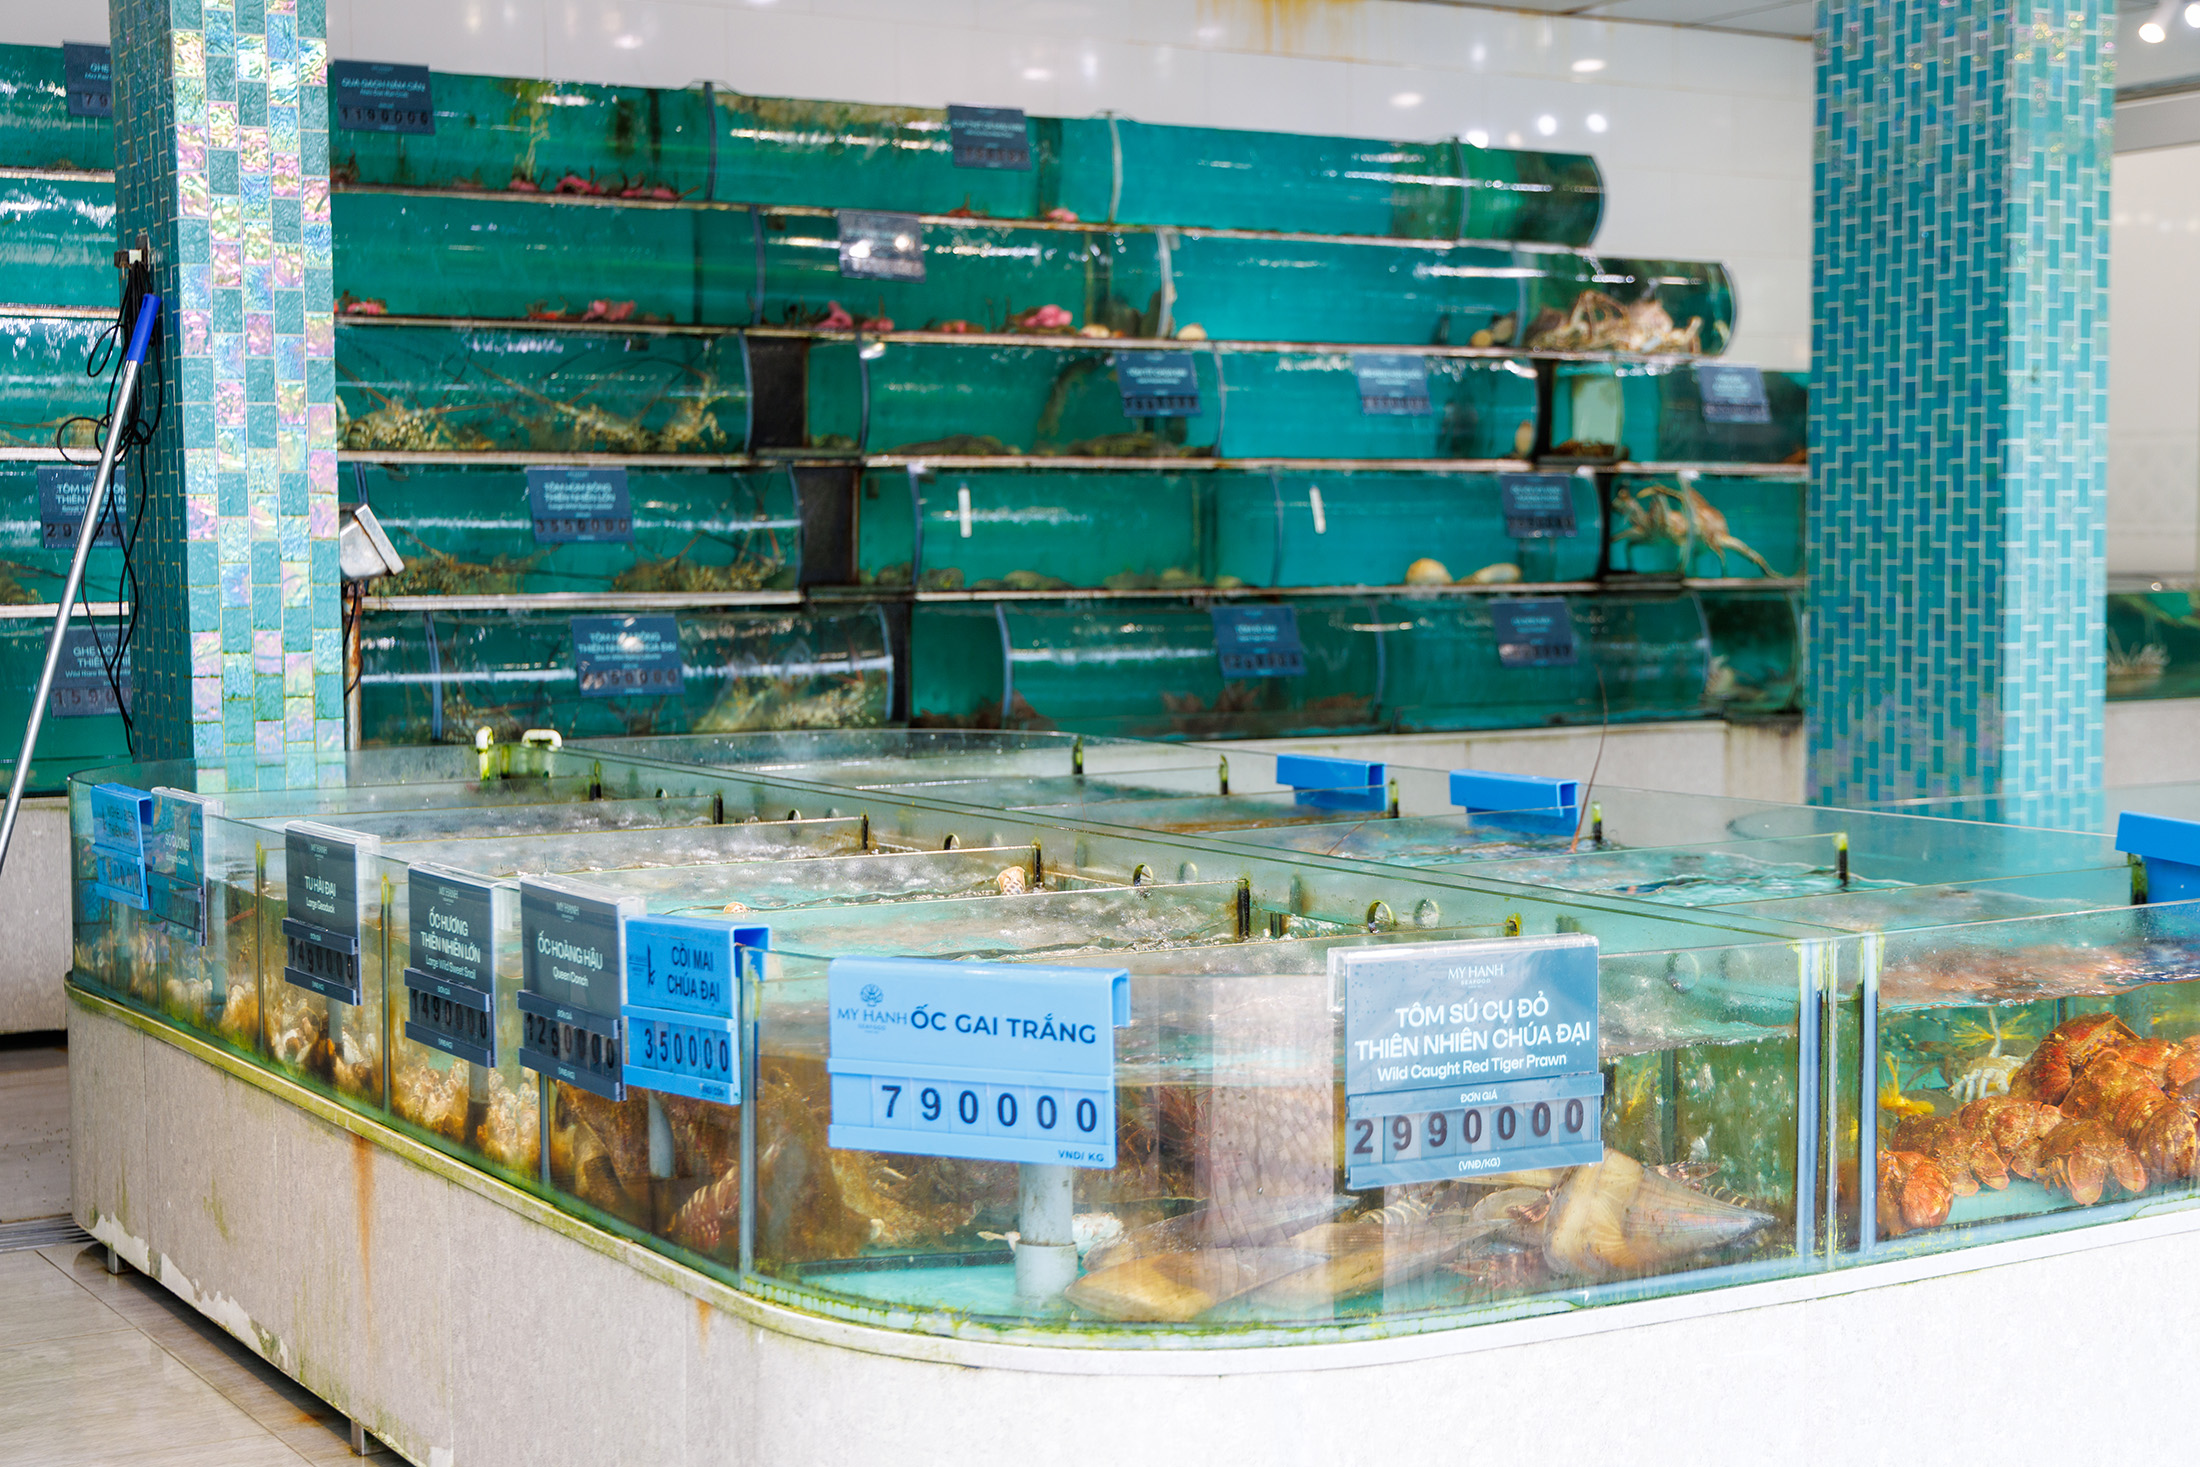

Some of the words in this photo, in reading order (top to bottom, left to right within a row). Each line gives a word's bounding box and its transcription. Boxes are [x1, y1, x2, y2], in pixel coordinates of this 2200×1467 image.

[304, 875, 313, 891] TU
[429, 906, 441, 929] ỐC
[421, 931, 441, 952] THIÊN
[442, 937, 464, 958] NHIÊN
[465, 942, 480, 963] LỚN
[538, 930, 551, 955] ỐC
[551, 940, 583, 965] HOÀNG
[584, 946, 603, 972] HẬU
[693, 948, 713, 972] MAI
[553, 966, 571, 981] Queen
[1448, 966, 1466, 980] MY
[1469, 964, 1504, 978] HANH
[667, 972, 698, 999] CHÚA
[700, 979, 720, 1007] ĐẠI
[838, 1008, 859, 1021] MY
[863, 1009, 907, 1025] HANH
[911, 1004, 947, 1030] ỐC
[955, 1013, 998, 1036] GAI
[1006, 1013, 1096, 1044] TRẮNG
[1395, 1001, 1444, 1028] TÔM
[1449, 998, 1477, 1024] SÚ
[1482, 998, 1513, 1023] CỤ
[1517, 990, 1549, 1018] ĐỎ
[645, 1028, 728, 1072] 350000
[1354, 1033, 1419, 1061] THIÊN
[1423, 1027, 1488, 1055] NHIÊN
[1492, 1020, 1552, 1049] CHÚA
[1556, 1021, 1590, 1046] ĐẠI
[1377, 1065, 1408, 1082] Wild
[1411, 1062, 1460, 1080] Caught
[1463, 1059, 1489, 1074] Red
[1492, 1056, 1524, 1075] Tiger
[1526, 1053, 1567, 1068] Prawn
[881, 1084, 1097, 1132] 790000
[1460, 1090, 1481, 1103] ĐƠN
[1482, 1088, 1498, 1101] GIÁ
[1353, 1098, 1584, 1155] 2990000
[1088, 1152, 1104, 1162] KG
